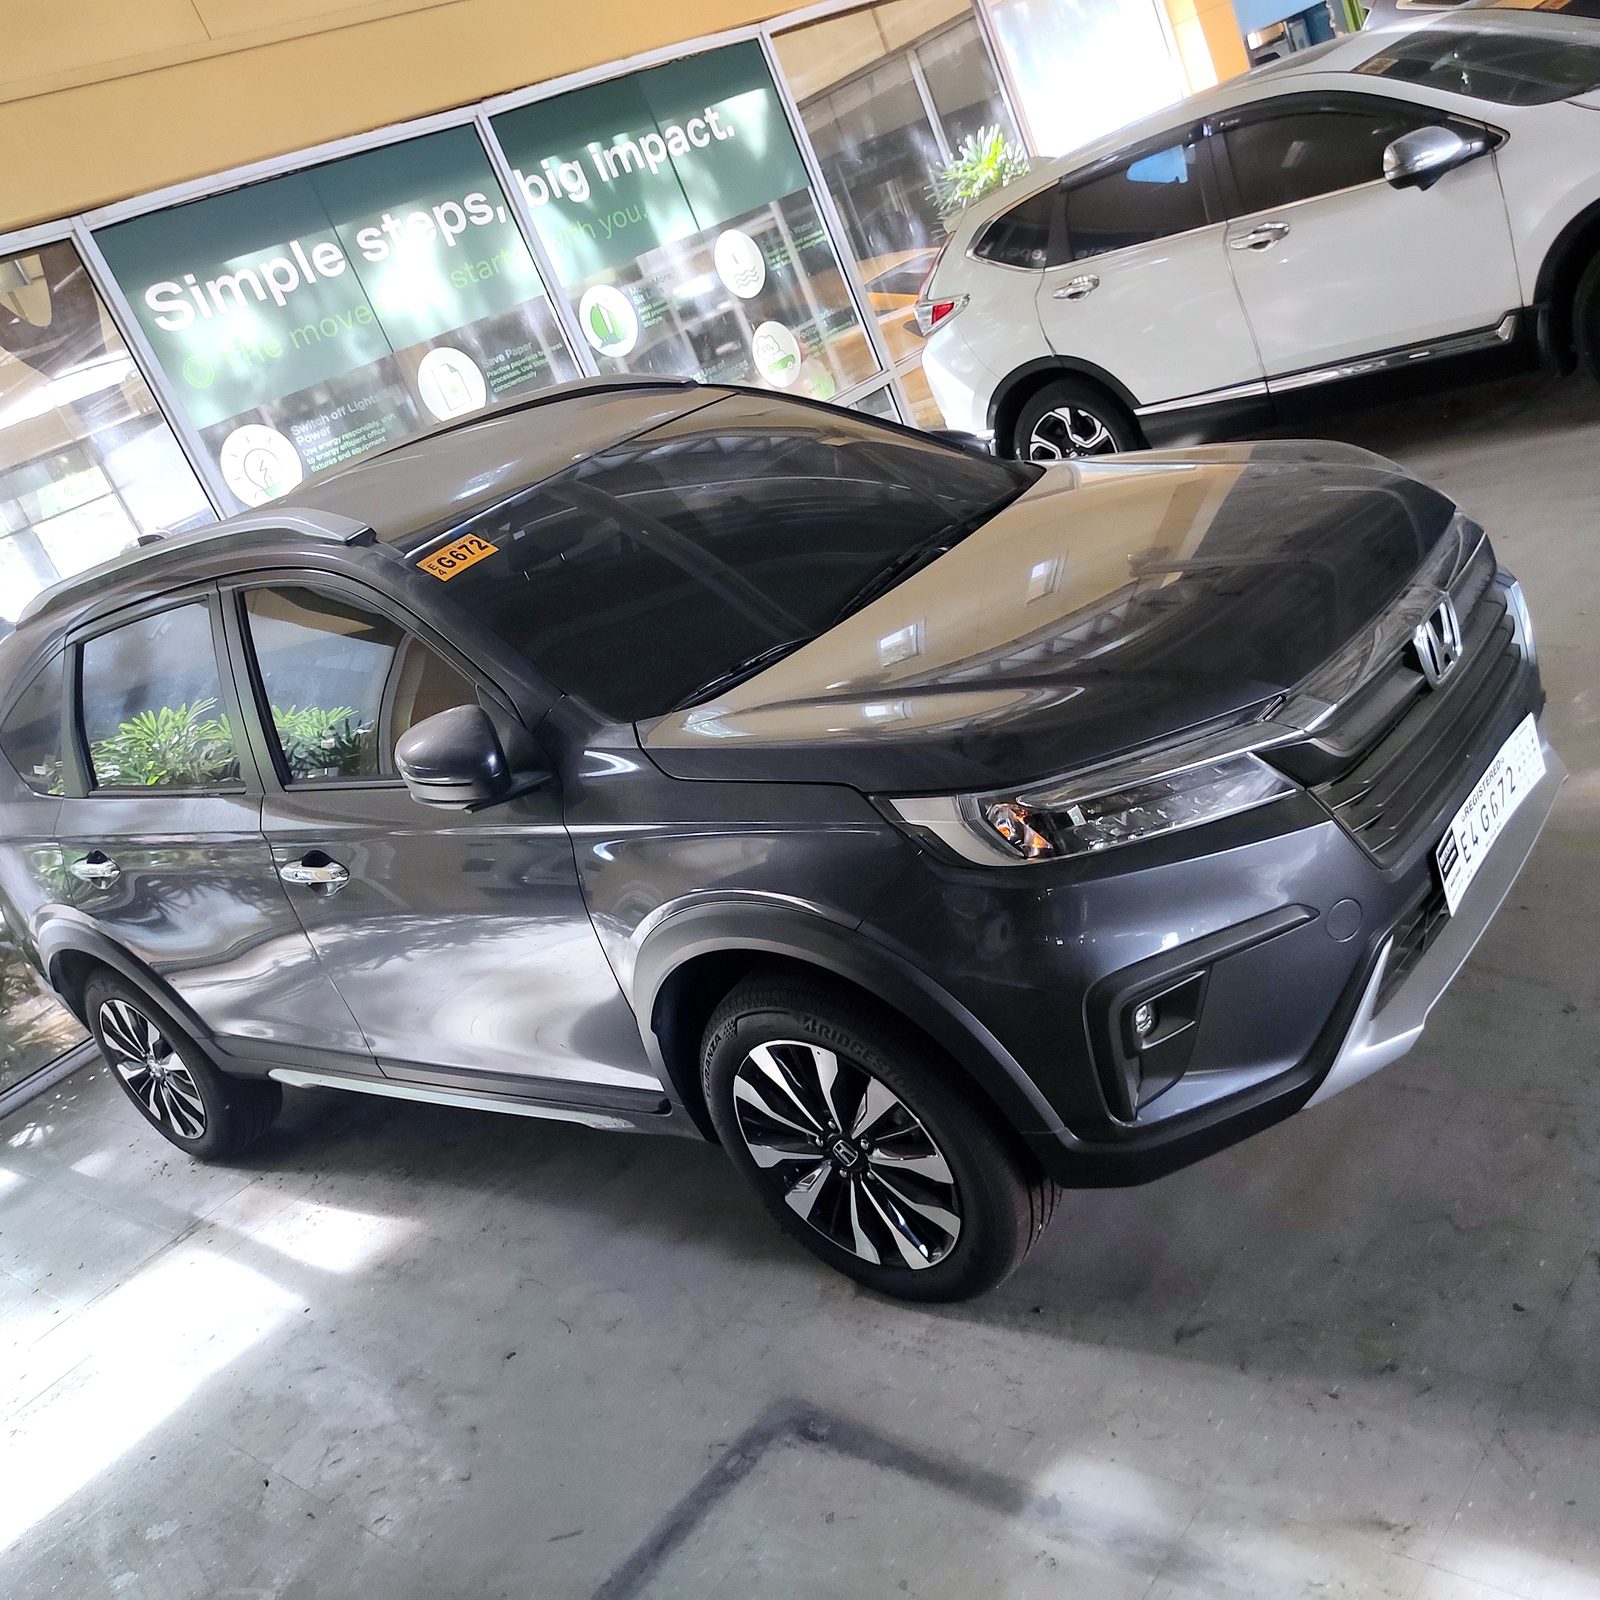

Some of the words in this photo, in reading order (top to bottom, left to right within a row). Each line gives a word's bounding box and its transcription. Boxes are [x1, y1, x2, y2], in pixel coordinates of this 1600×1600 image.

[144, 240, 347, 332] Simple
[356, 192, 508, 263] steps,
[513, 157, 591, 208] big
[586, 107, 736, 182] impact.
[600, 204, 649, 240] you.
[481, 353, 506, 369] Save
[504, 342, 533, 360] Paper
[520, 363, 534, 373] Use
[486, 365, 511, 379] Practice
[493, 371, 537, 394] conscientiously
[290, 413, 331, 437] Switch
[330, 405, 347, 421] off
[295, 426, 331, 447] Power
[303, 446, 318, 457] Use
[318, 436, 342, 451] energy
[307, 456, 316, 465] to
[316, 447, 339, 462] energy
[340, 435, 367, 450] efficient
[367, 427, 386, 439] office
[310, 456, 338, 473] fixtures
[338, 450, 352, 462] and
[351, 436, 387, 456] equipment
[437, 539, 490, 568] G672
[1463, 758, 1502, 818] REGISTERED
